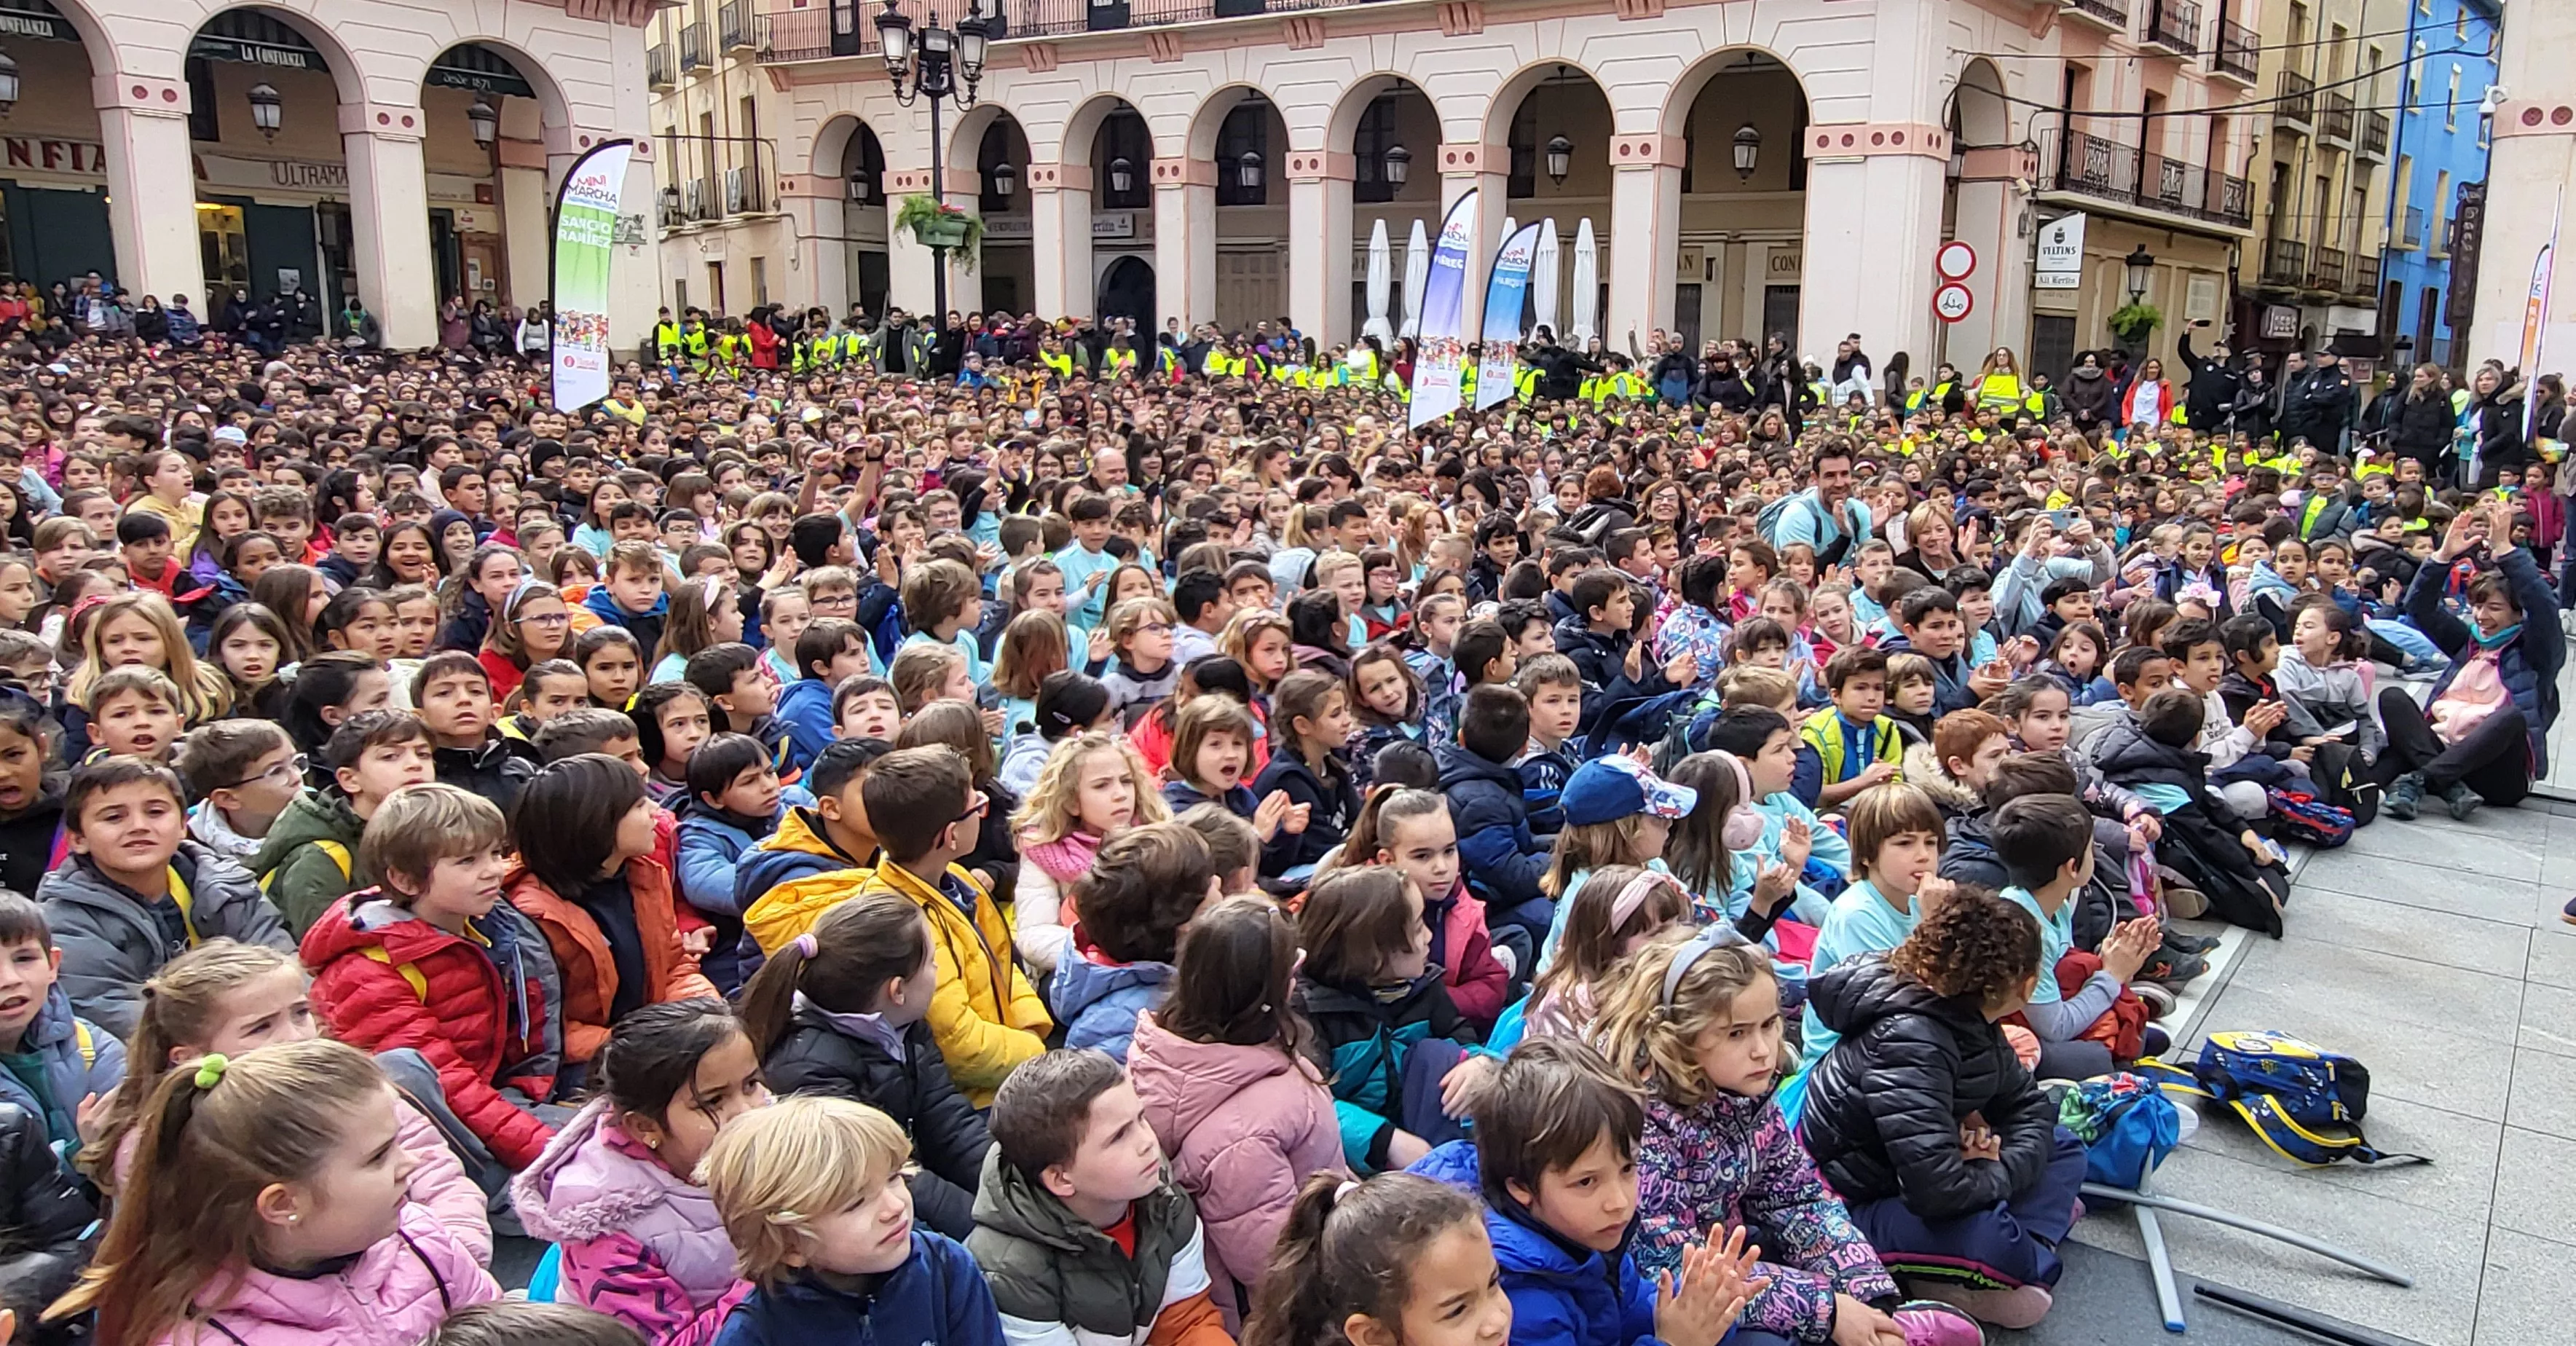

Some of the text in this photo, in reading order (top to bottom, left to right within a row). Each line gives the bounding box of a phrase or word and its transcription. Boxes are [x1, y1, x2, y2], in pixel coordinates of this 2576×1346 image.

[241, 44, 307, 68] LA CONFIANZA
[443, 73, 491, 89] desde 1871
[567, 184, 618, 205] MARCHA
